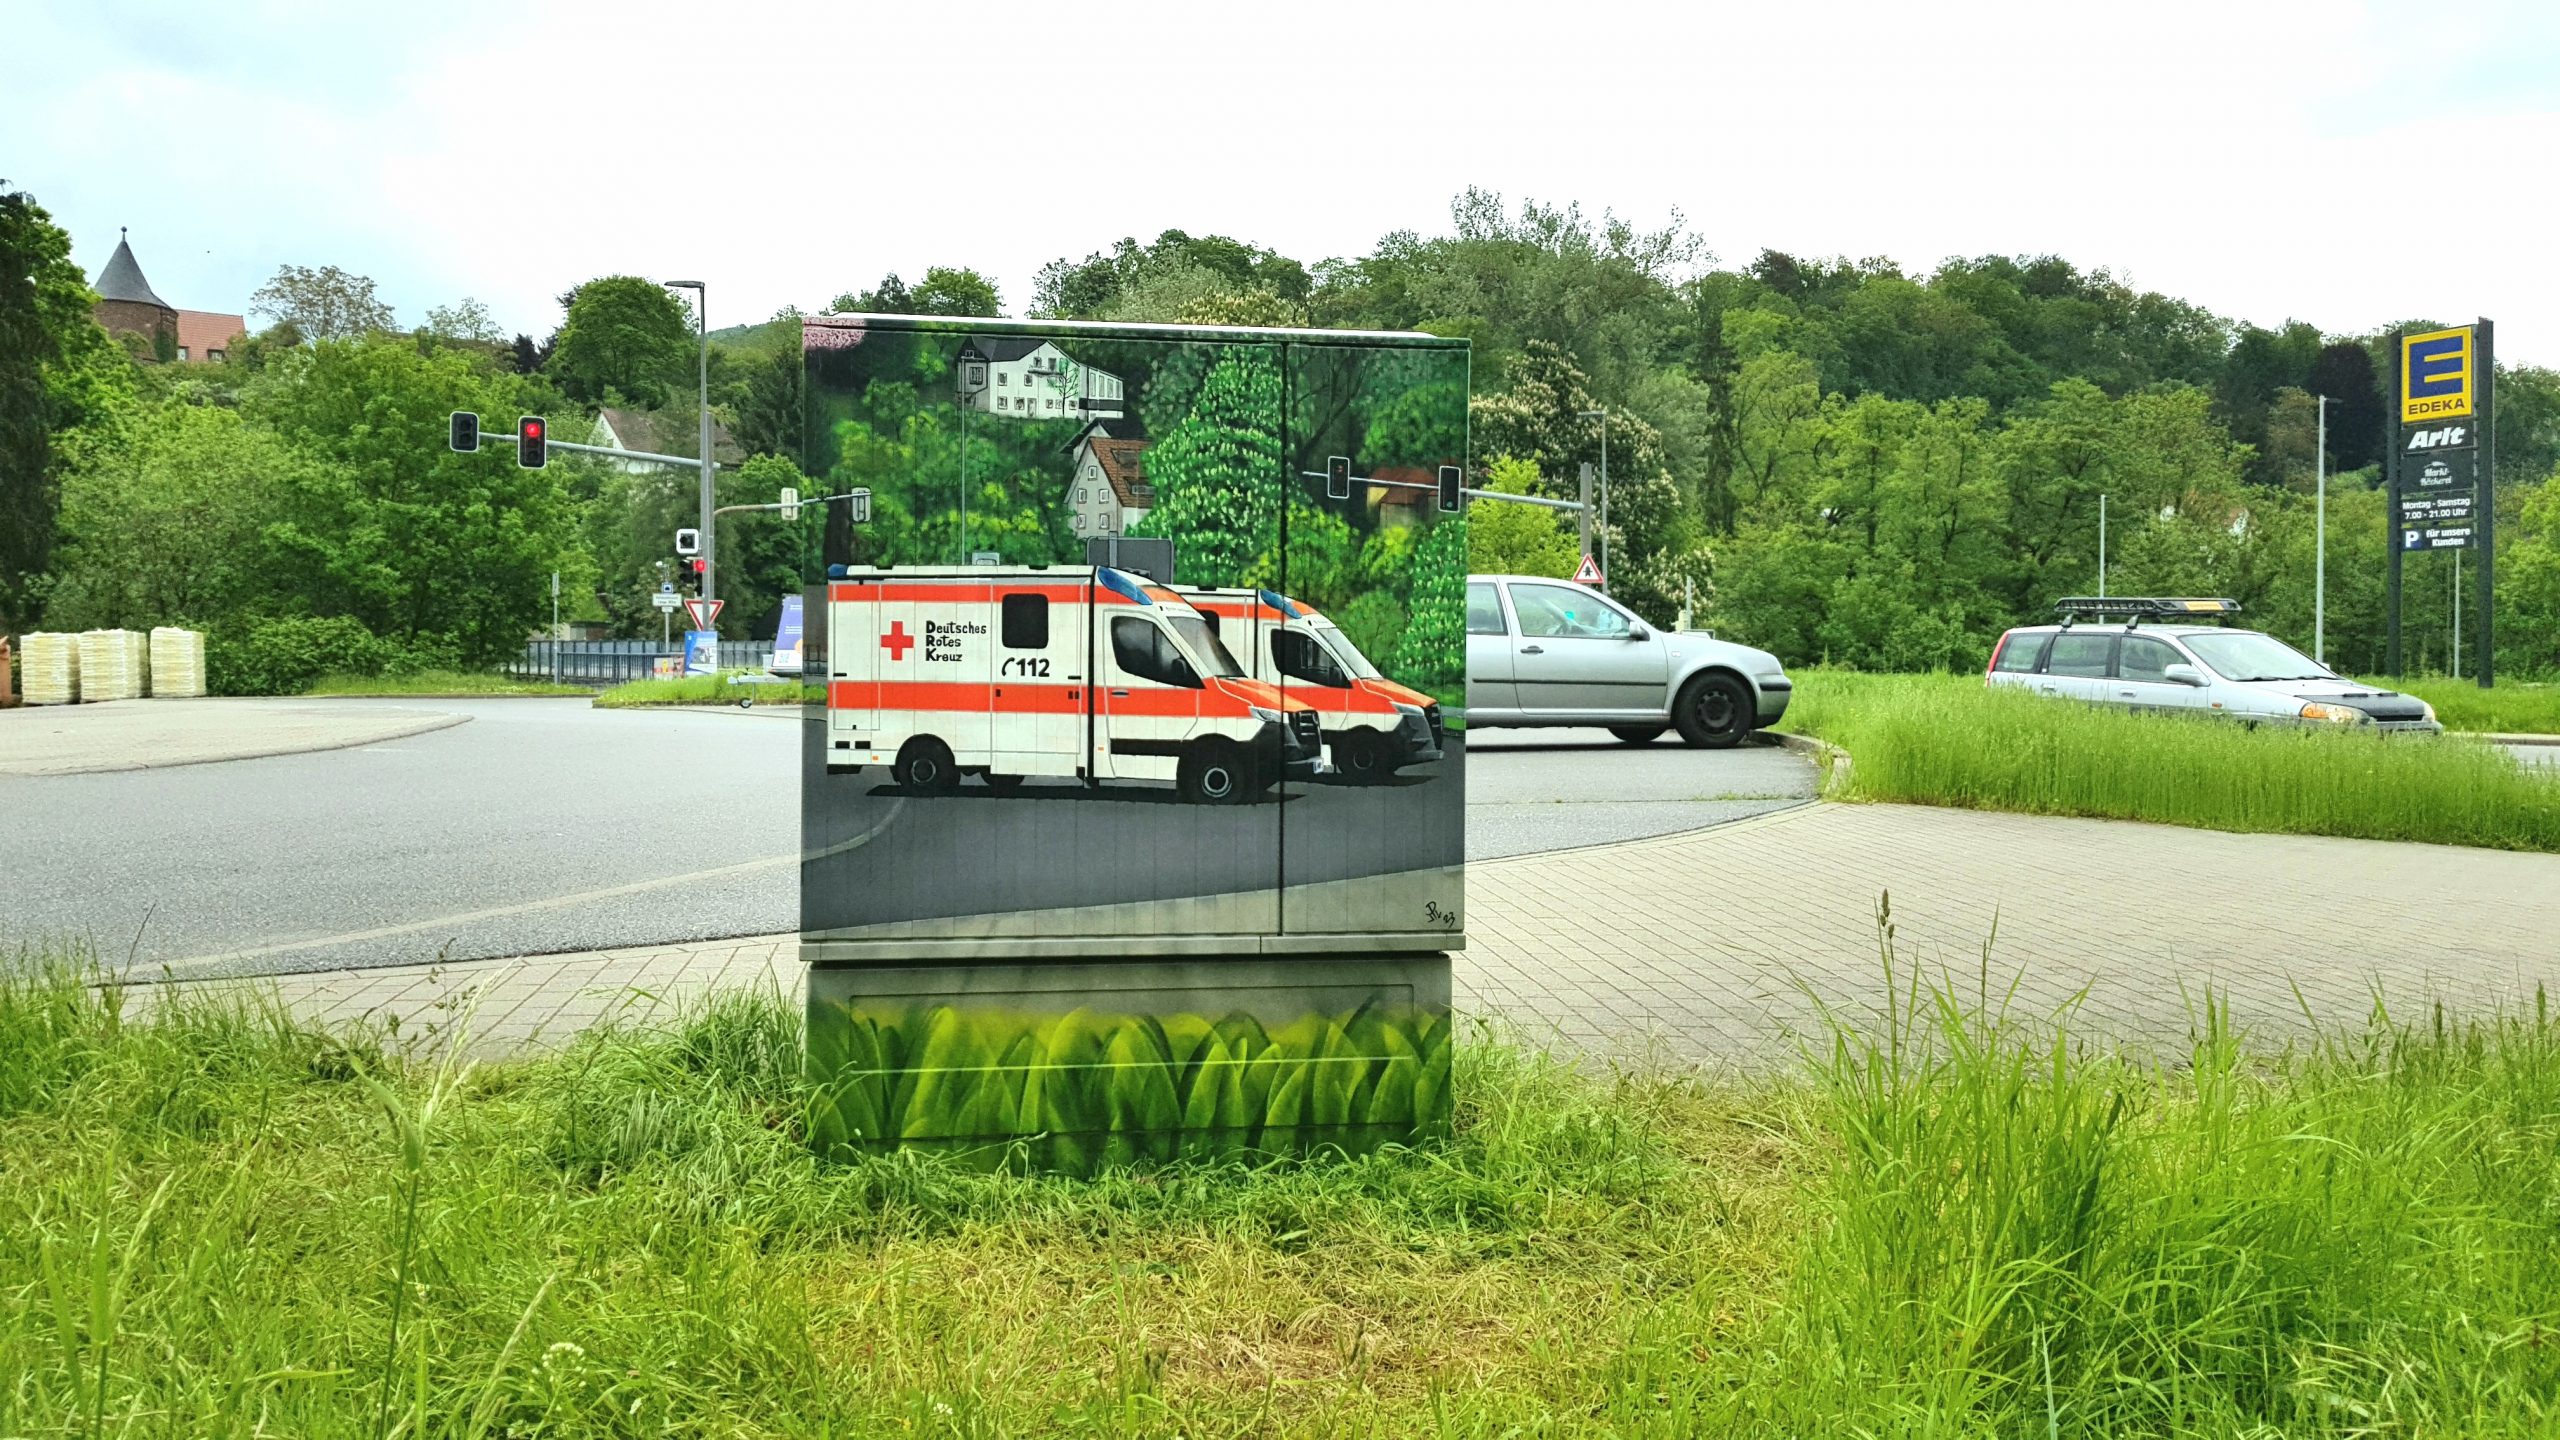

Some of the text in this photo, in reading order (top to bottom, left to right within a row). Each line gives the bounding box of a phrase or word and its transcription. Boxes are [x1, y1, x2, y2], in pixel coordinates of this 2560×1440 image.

[2408, 398, 2465, 415] EDEKA
[2408, 427, 2466, 449] Arlt
[2402, 501, 2431, 510] Montag
[2437, 498, 2471, 507] Samstag
[2405, 511, 2422, 520] 7.00
[2428, 509, 2451, 518] 21.00
[2452, 508, 2468, 516] Uhr
[2405, 530, 2419, 548] P
[2426, 528, 2471, 538] für unsere
[2432, 538, 2465, 546] Kunden
[925, 620, 987, 634] Deutsches
[925, 634, 962, 647] Rotes
[925, 647, 963, 661] Kreuz
[1015, 657, 1050, 677] 112
